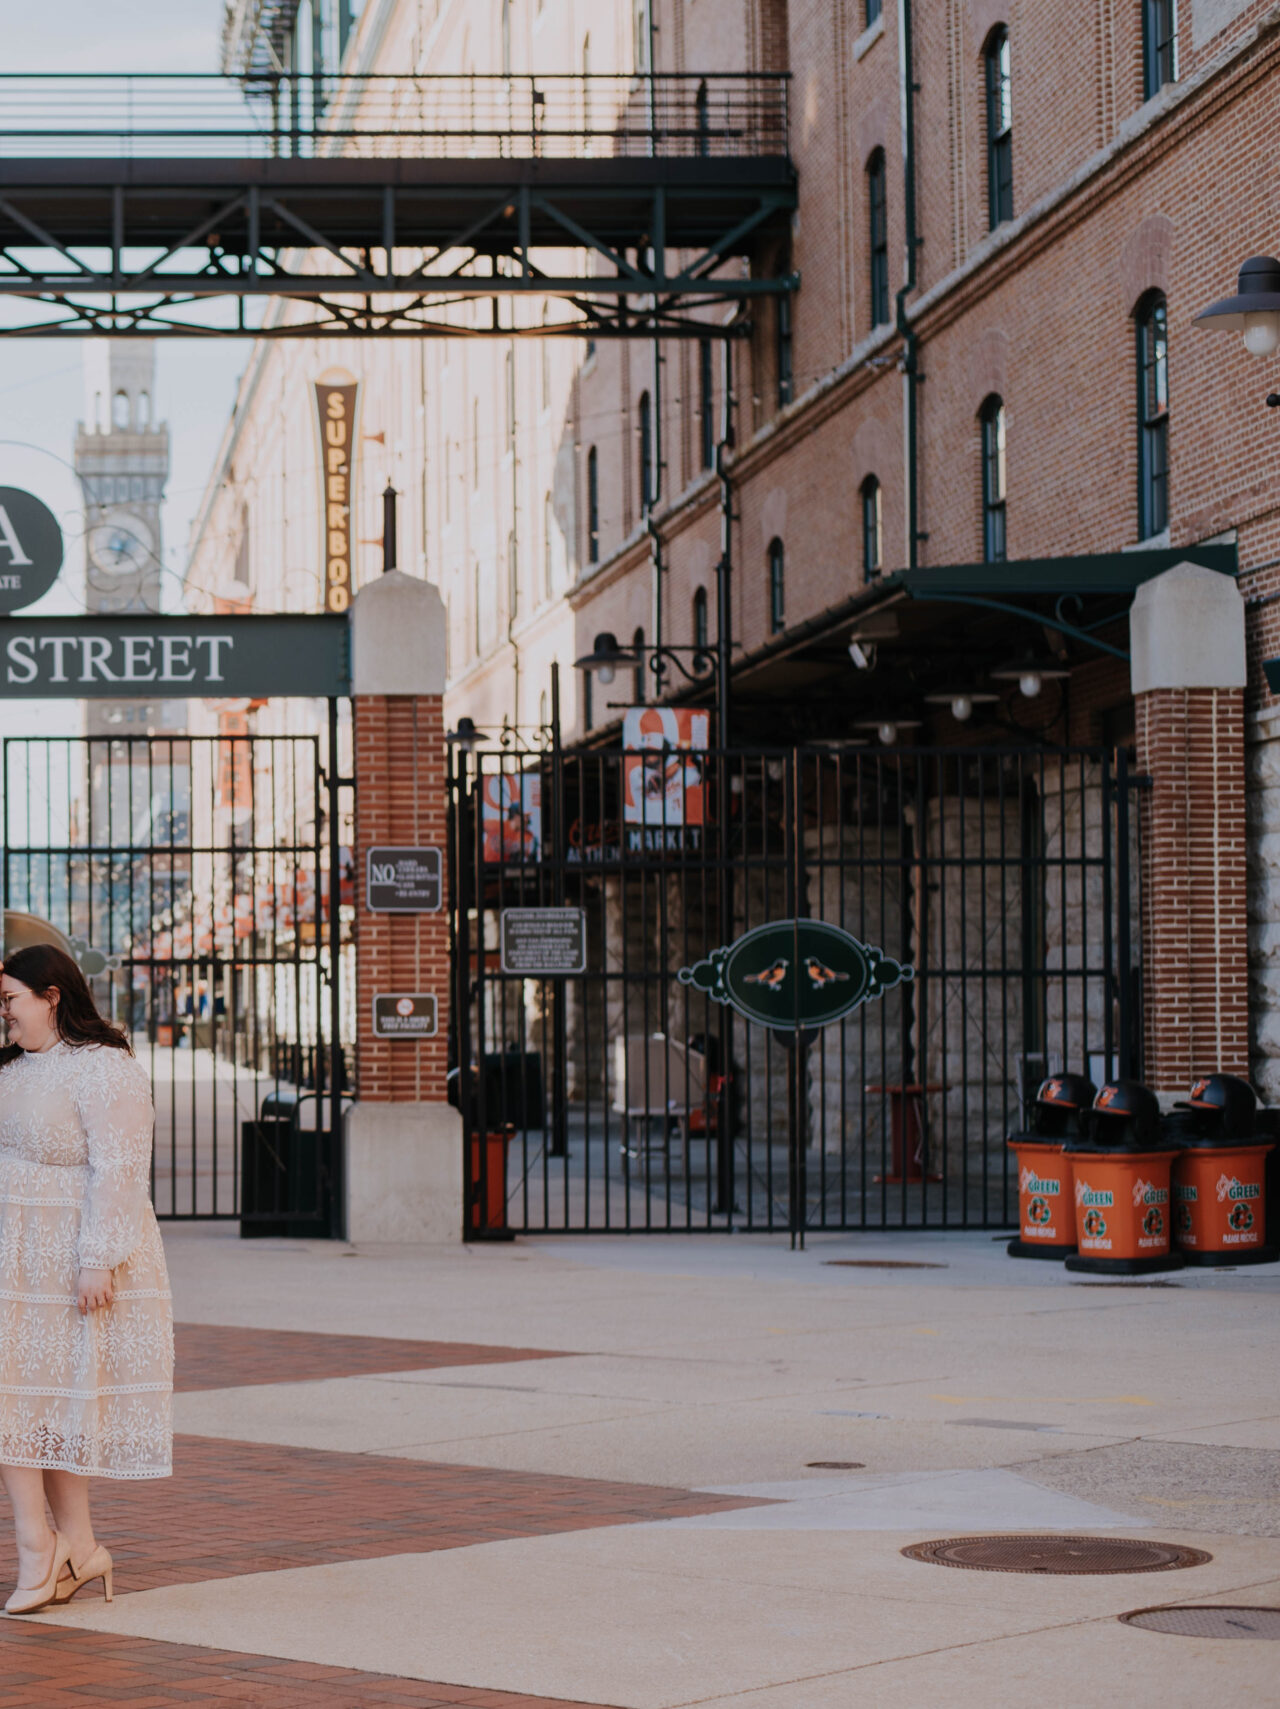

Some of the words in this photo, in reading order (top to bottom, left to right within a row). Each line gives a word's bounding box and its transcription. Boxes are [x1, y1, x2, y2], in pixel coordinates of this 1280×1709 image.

[6, 635, 233, 684] STREET
[371, 863, 395, 884] NO
[1028, 1180, 1060, 1195] GREEN
[1229, 1184, 1260, 1200] GREEN
[1083, 1191, 1114, 1207] GREEN
